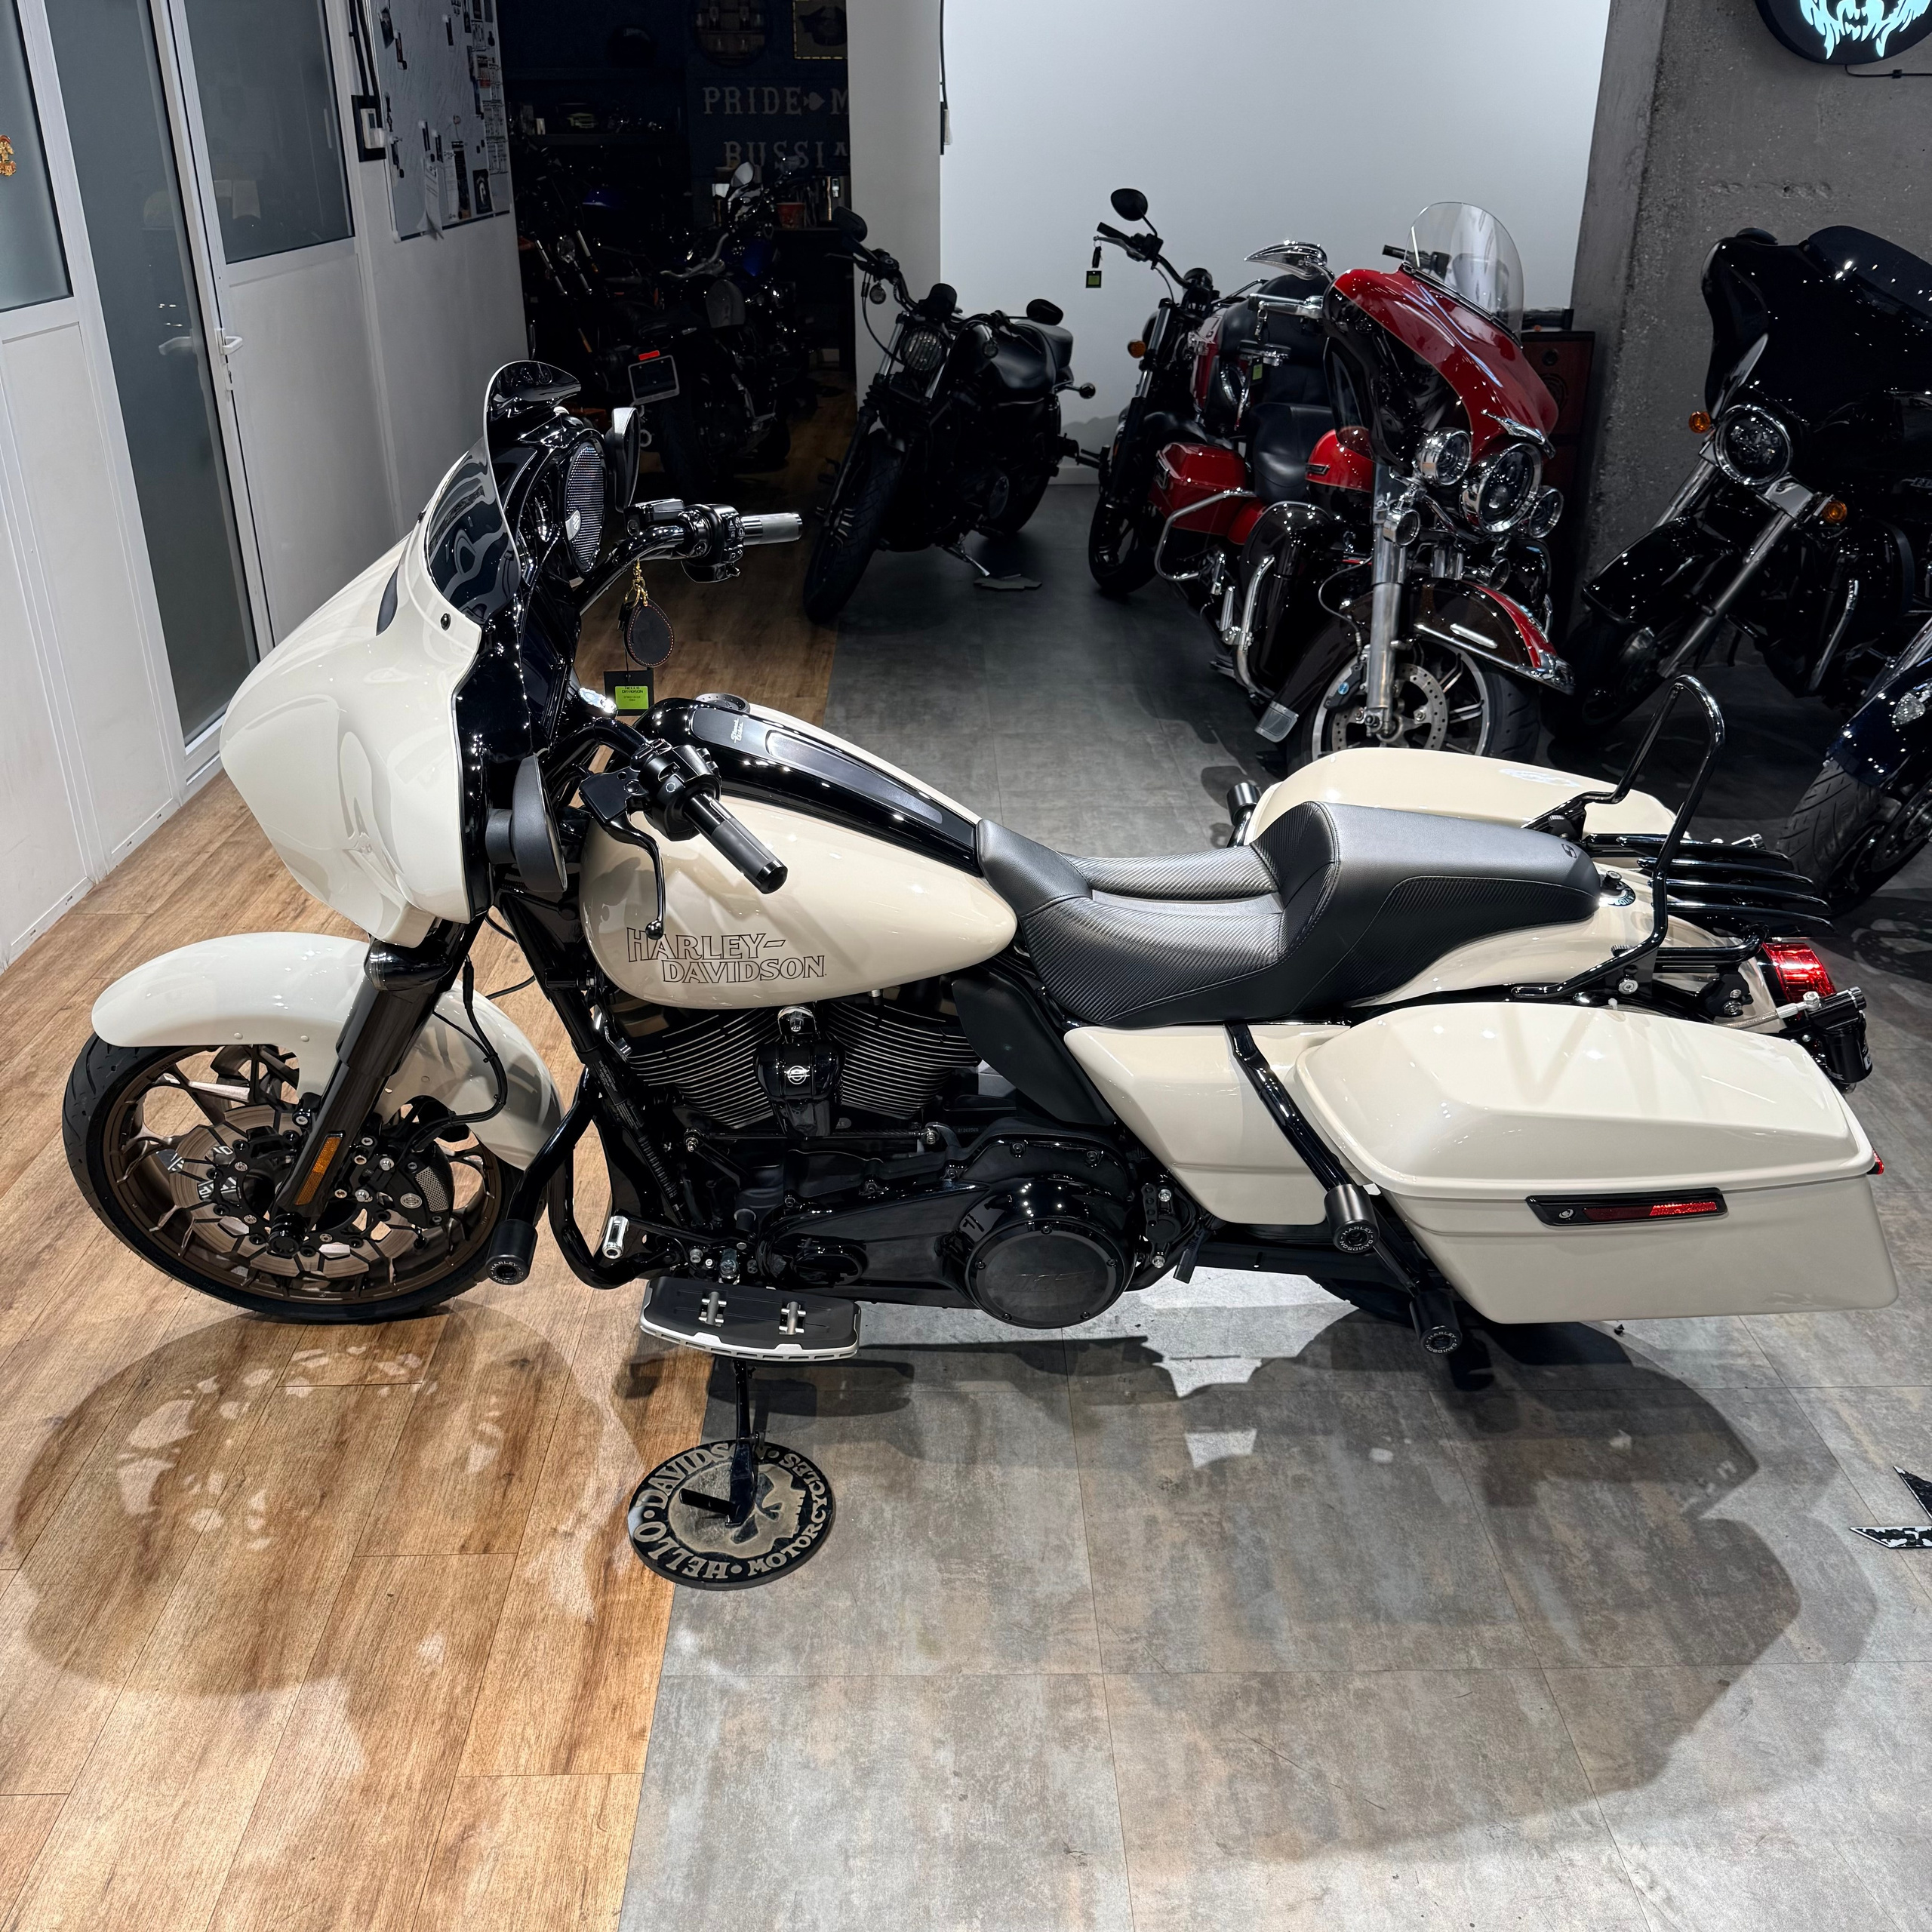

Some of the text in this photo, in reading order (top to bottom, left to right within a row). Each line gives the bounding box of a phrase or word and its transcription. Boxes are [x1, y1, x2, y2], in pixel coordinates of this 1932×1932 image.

[702, 86, 802, 115] PRIDE
[661, 955, 826, 983] DAVIDSON
[633, 1442, 828, 1580] HELLO DAVIDSN MOTORCYCLES
